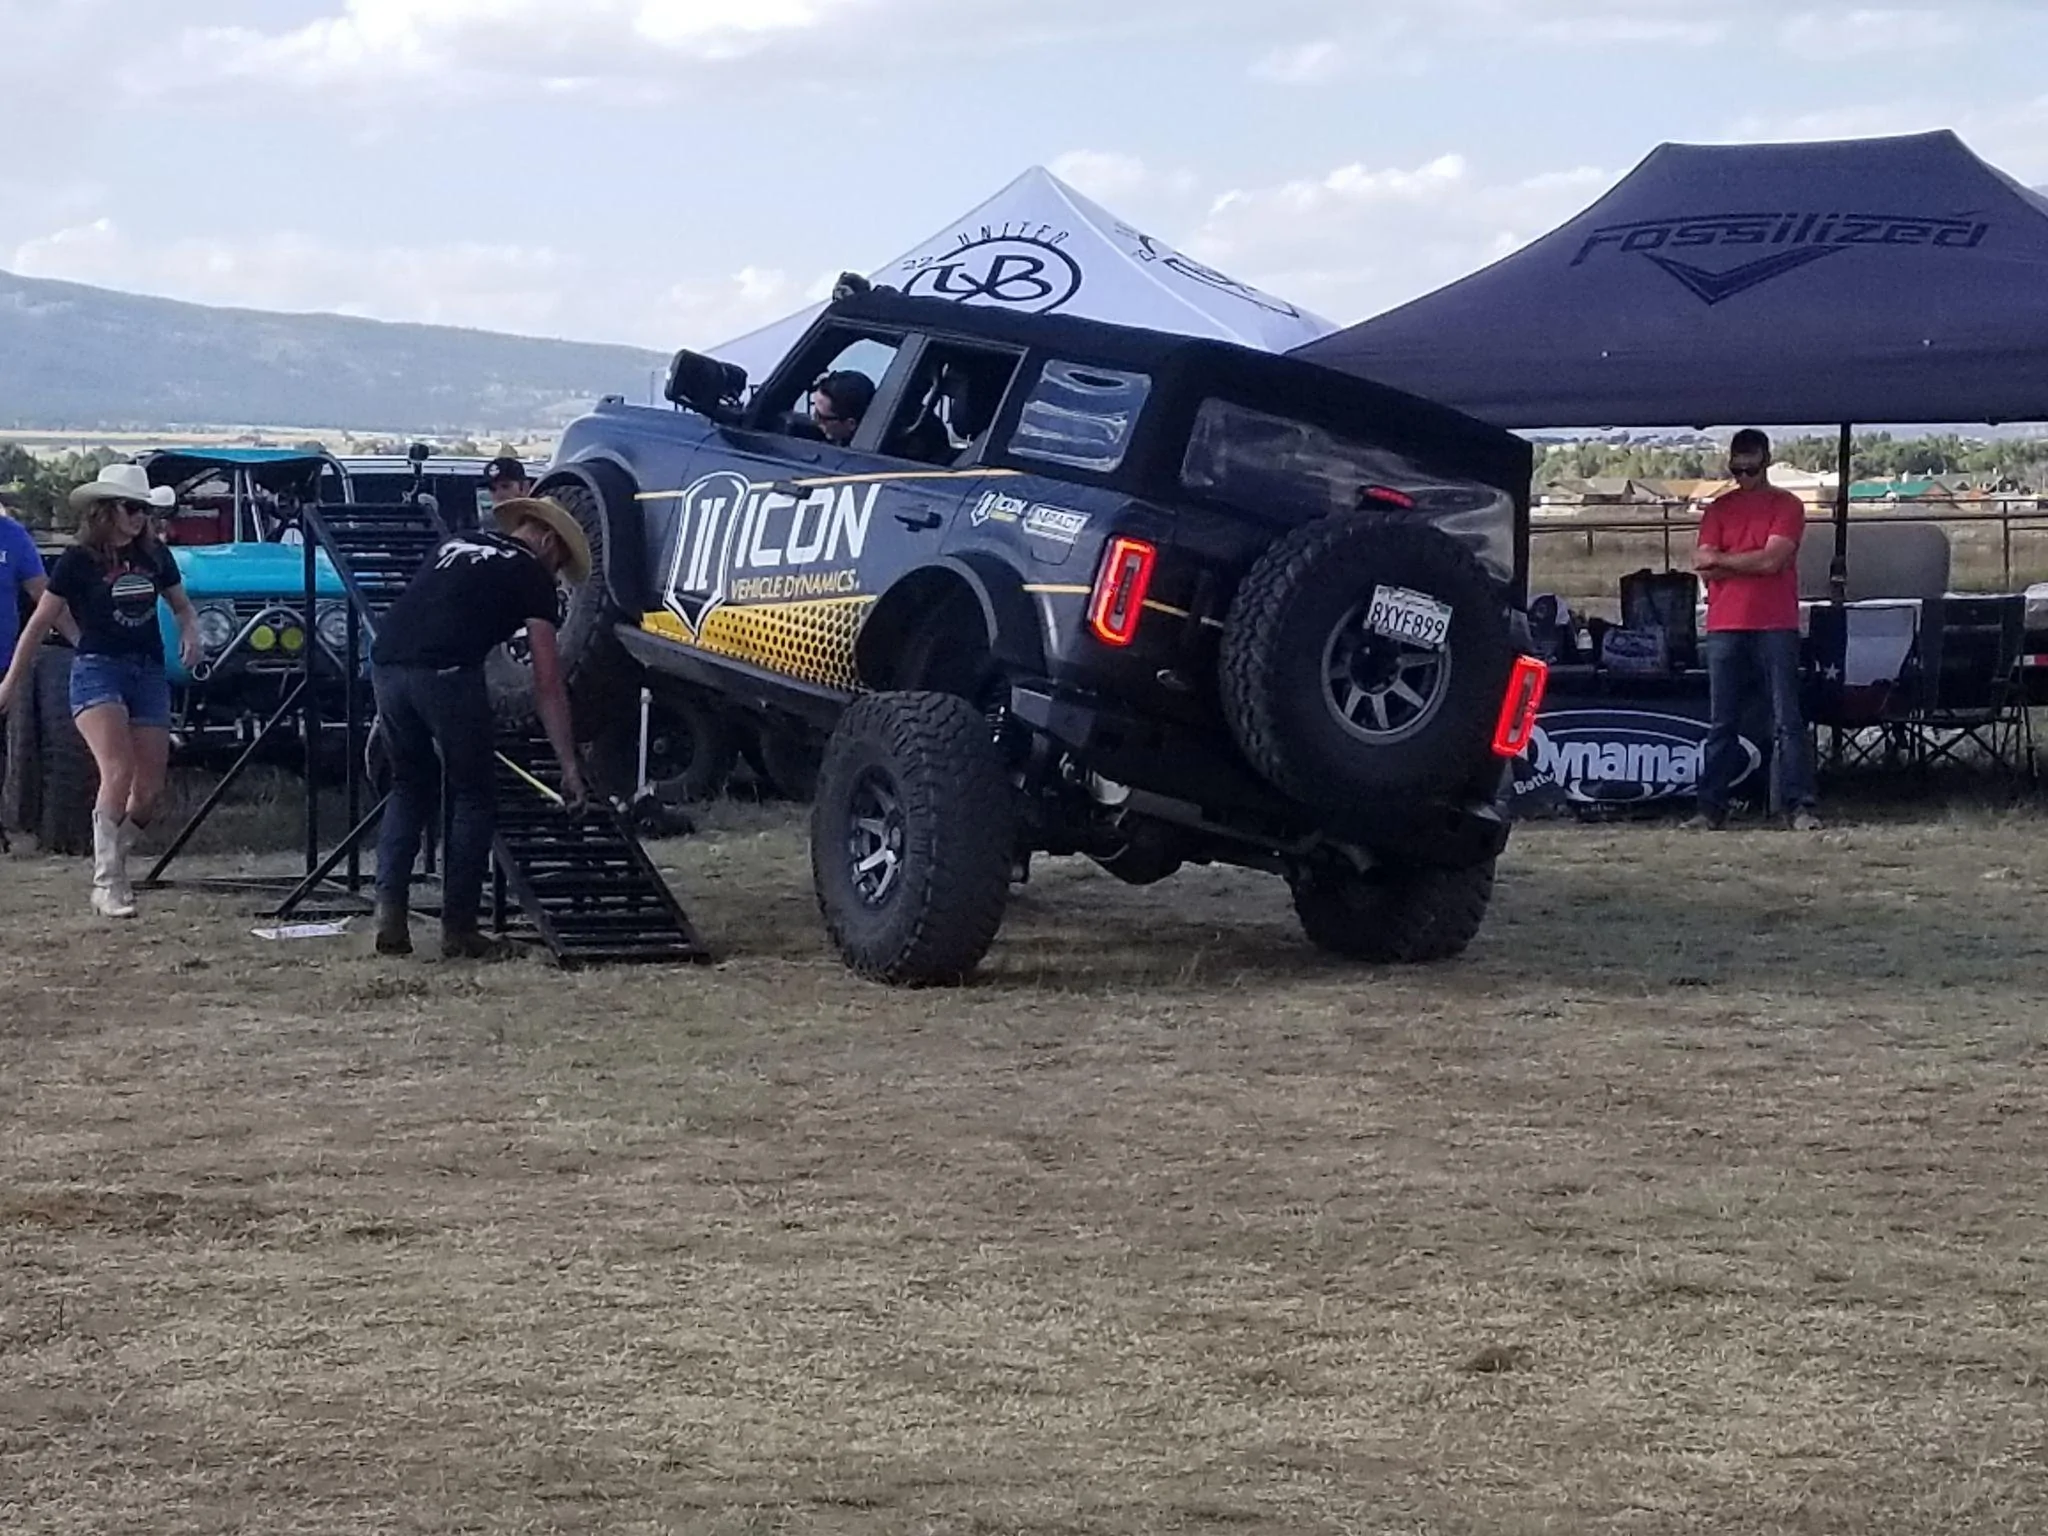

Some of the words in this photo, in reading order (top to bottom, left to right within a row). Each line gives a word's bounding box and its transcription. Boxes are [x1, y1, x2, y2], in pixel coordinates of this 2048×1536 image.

[957, 221, 1069, 246] UNITED
[734, 482, 882, 569] ICON
[731, 577, 781, 600] VEHICLE
[1371, 601, 1445, 643] 8XYF899
